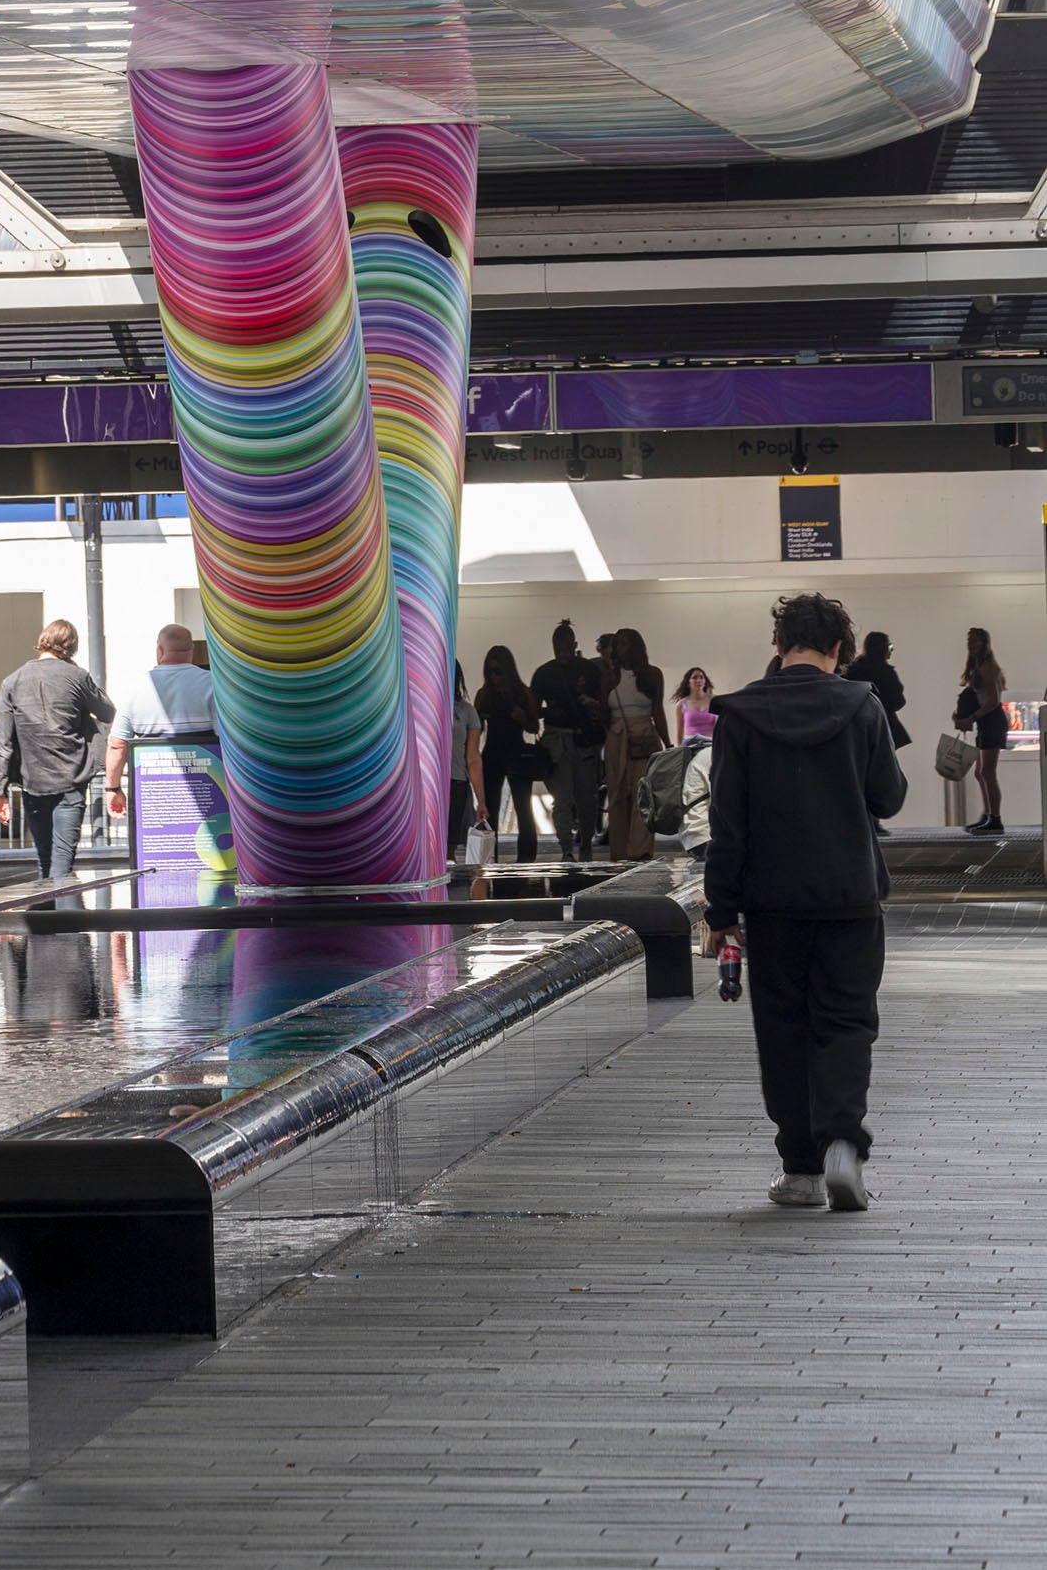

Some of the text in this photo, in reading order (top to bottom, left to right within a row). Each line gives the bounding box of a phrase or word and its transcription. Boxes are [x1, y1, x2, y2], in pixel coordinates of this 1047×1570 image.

[481, 443, 623, 462] West India Quay
[757, 440, 810, 458] Poplr
